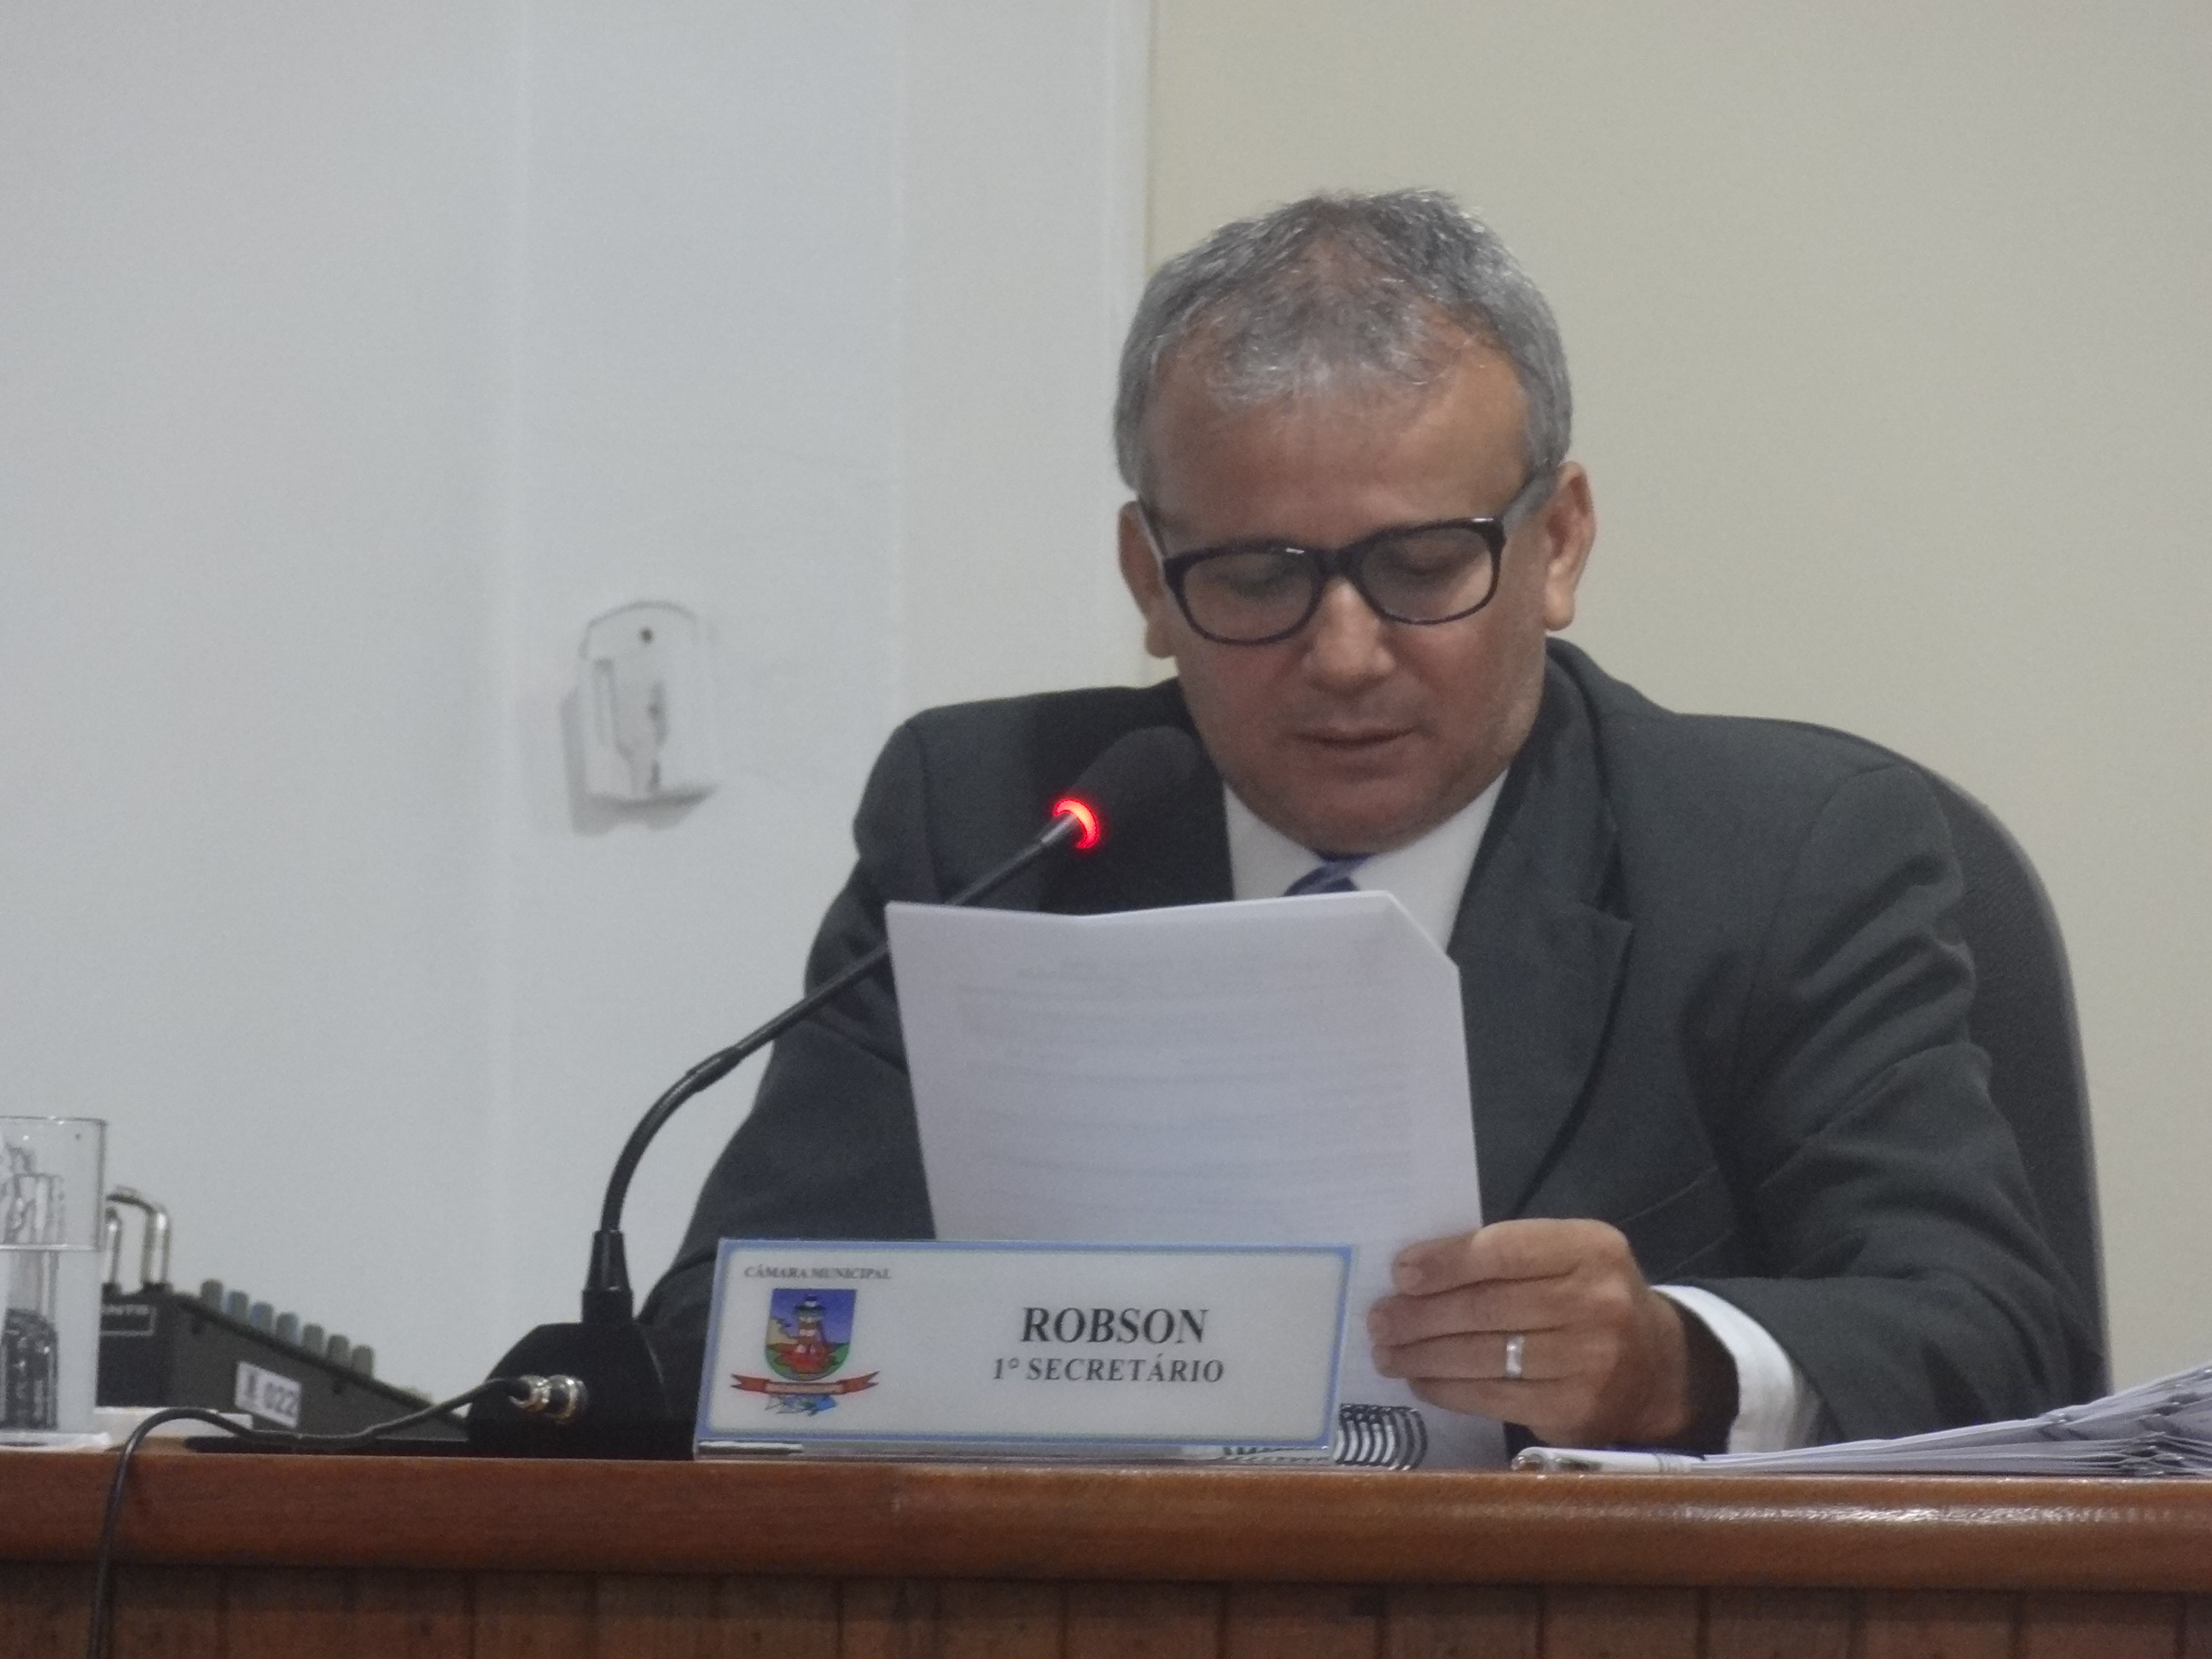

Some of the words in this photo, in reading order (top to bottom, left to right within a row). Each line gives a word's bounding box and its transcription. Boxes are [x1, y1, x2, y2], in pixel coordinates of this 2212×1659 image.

[812, 1267, 892, 1279] MUNICIPAL
[1021, 1307, 1209, 1344] ROBSON
[1026, 1353, 1225, 1382] SECRETÁRIO
